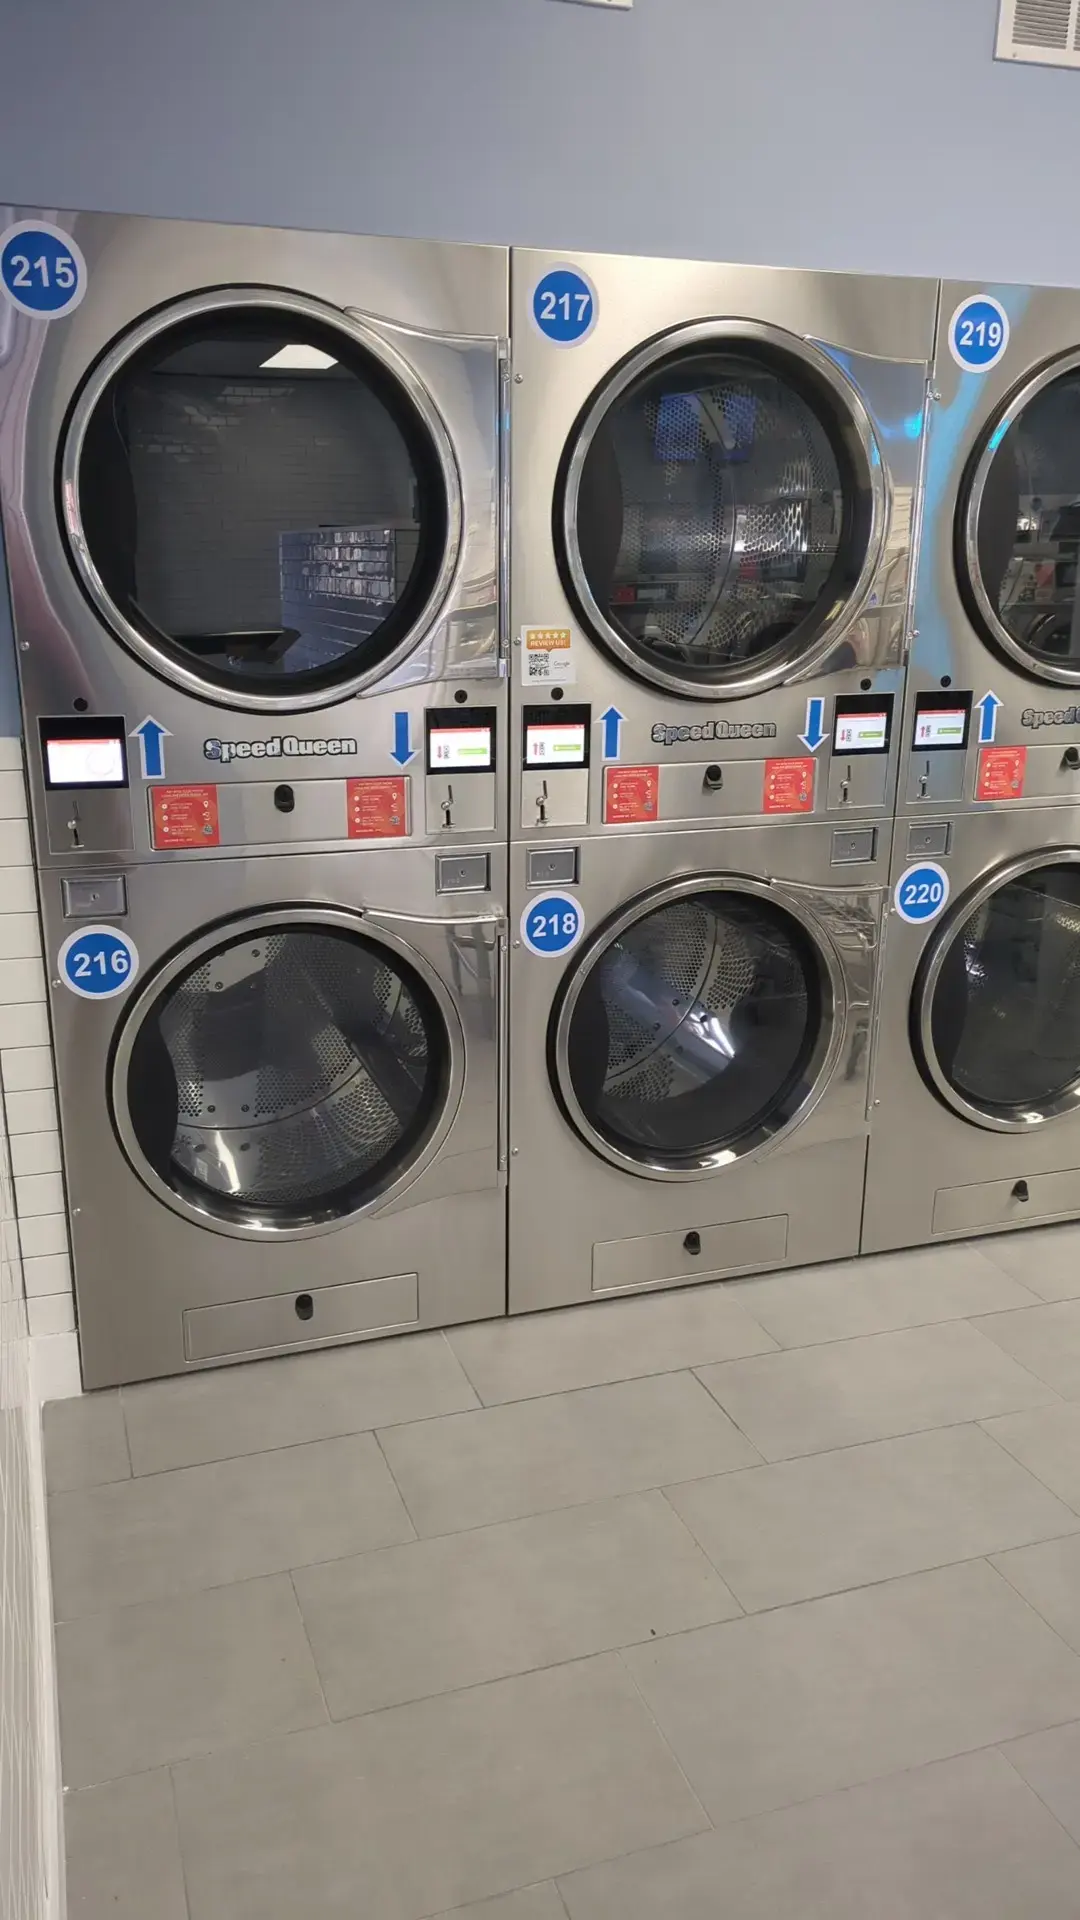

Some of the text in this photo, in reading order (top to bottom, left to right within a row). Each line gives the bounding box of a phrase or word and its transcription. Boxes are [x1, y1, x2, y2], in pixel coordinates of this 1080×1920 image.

[10, 255, 75, 288] 215
[540, 291, 590, 322] 217
[959, 320, 1001, 347] 219
[530, 639, 555, 647] REVIEW
[651, 720, 776, 745] Speed Queen
[204, 735, 357, 763] Speed Queen
[904, 882, 942, 905] 220
[532, 912, 576, 938] 218
[73, 949, 129, 977] 216
